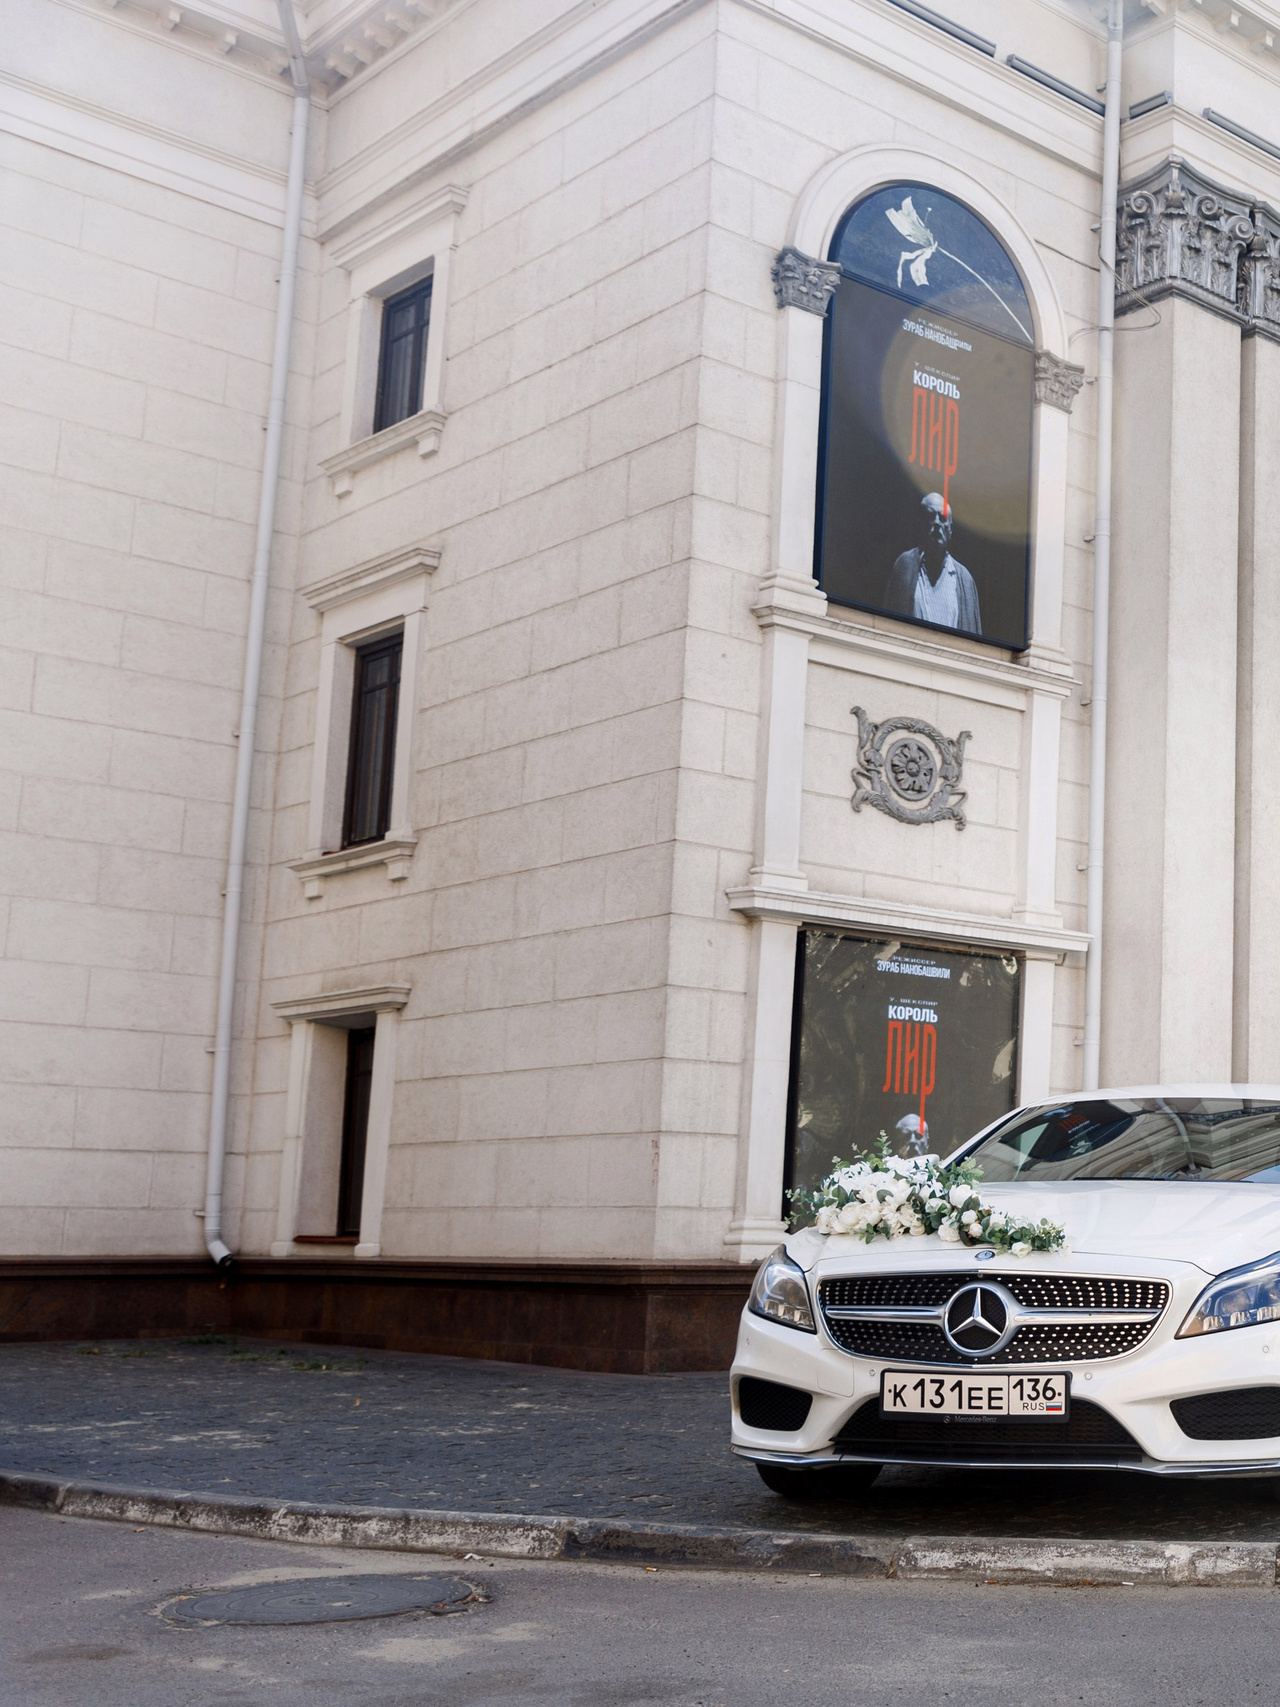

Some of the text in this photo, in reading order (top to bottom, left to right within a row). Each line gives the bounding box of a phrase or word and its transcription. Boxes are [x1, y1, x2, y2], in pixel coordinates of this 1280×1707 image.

[902, 318, 925, 337] ЗУРАБ
[913, 369, 961, 400] КОРОЛЬ
[908, 386, 960, 518] ЛИР
[876, 960, 951, 979] ЗУРАБ НАНОБАШВИЛИ
[900, 998, 938, 1006] ШЕКСПИР
[887, 1004, 939, 1023] КОРОЛЬ
[882, 1021, 937, 1135] ЛИР
[1012, 1377, 1057, 1401] 136
[1022, 1402, 1045, 1411] RUS
[954, 1415, 997, 1423] Mercedes-Benz
